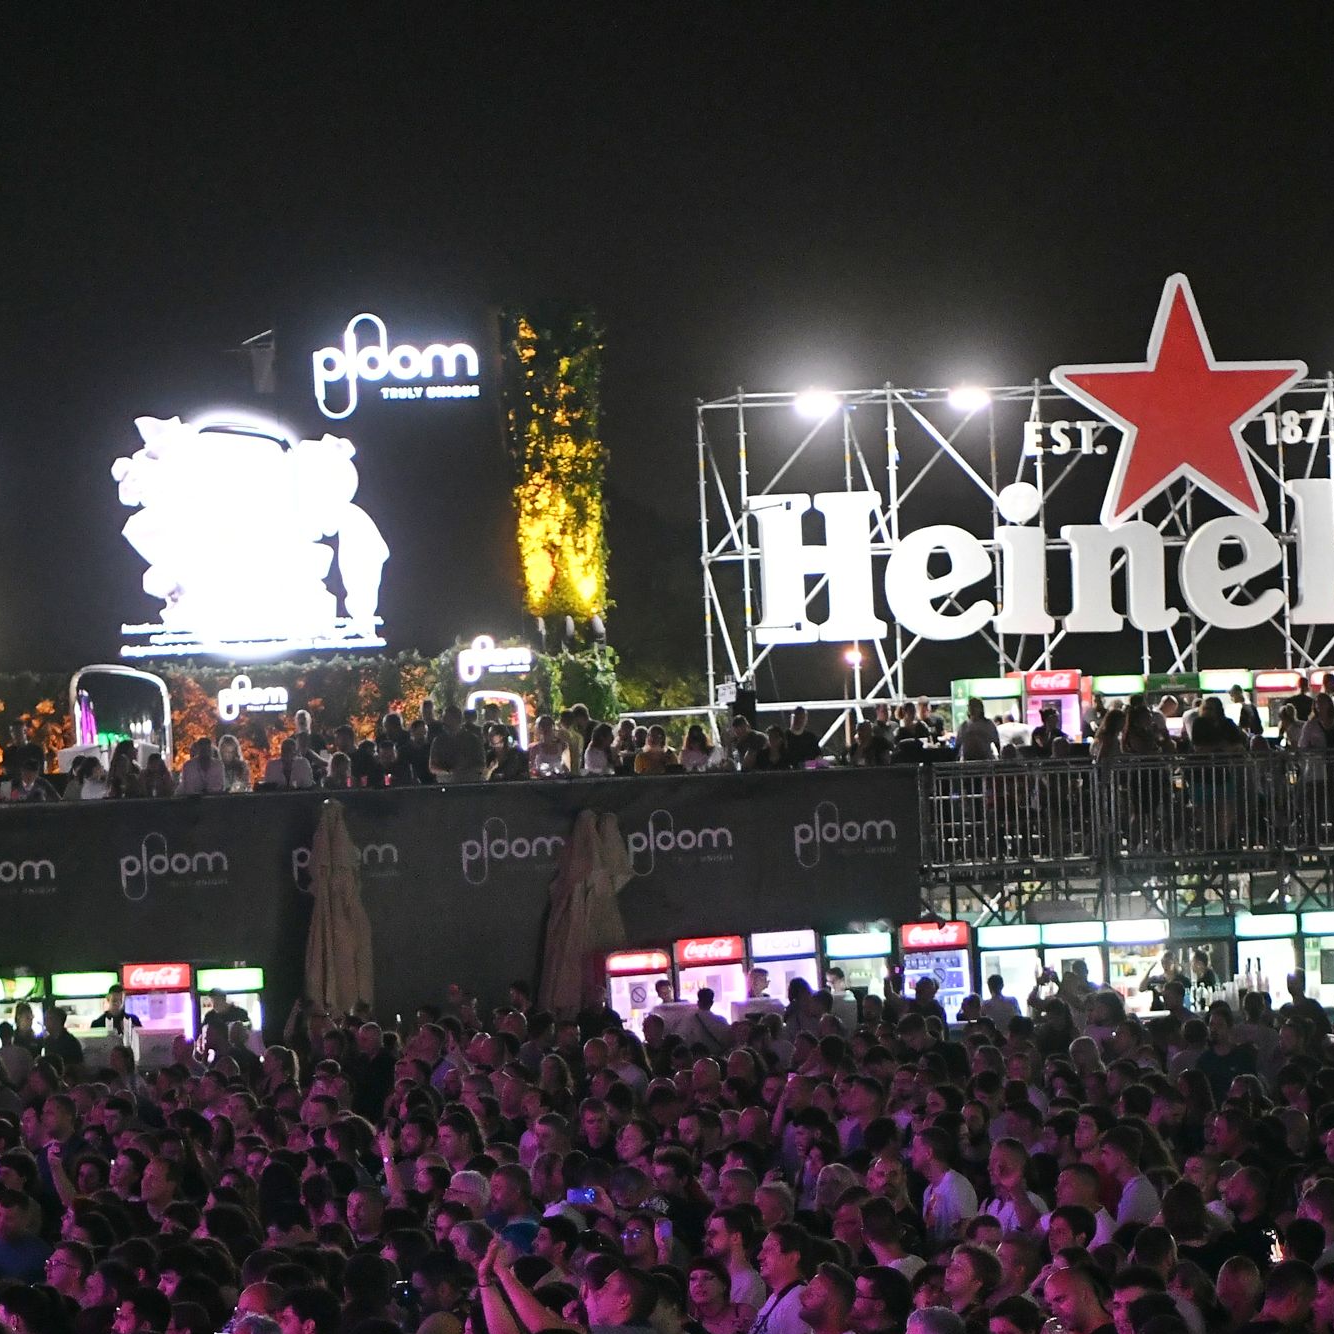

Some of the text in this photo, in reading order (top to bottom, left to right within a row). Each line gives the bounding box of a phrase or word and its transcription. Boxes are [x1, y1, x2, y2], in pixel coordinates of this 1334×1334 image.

[312, 312, 479, 420] ploom
[1024, 420, 1108, 456] EST.
[120, 832, 229, 900] ploom
[628, 809, 733, 877] ploom
[794, 800, 897, 868] ploom
